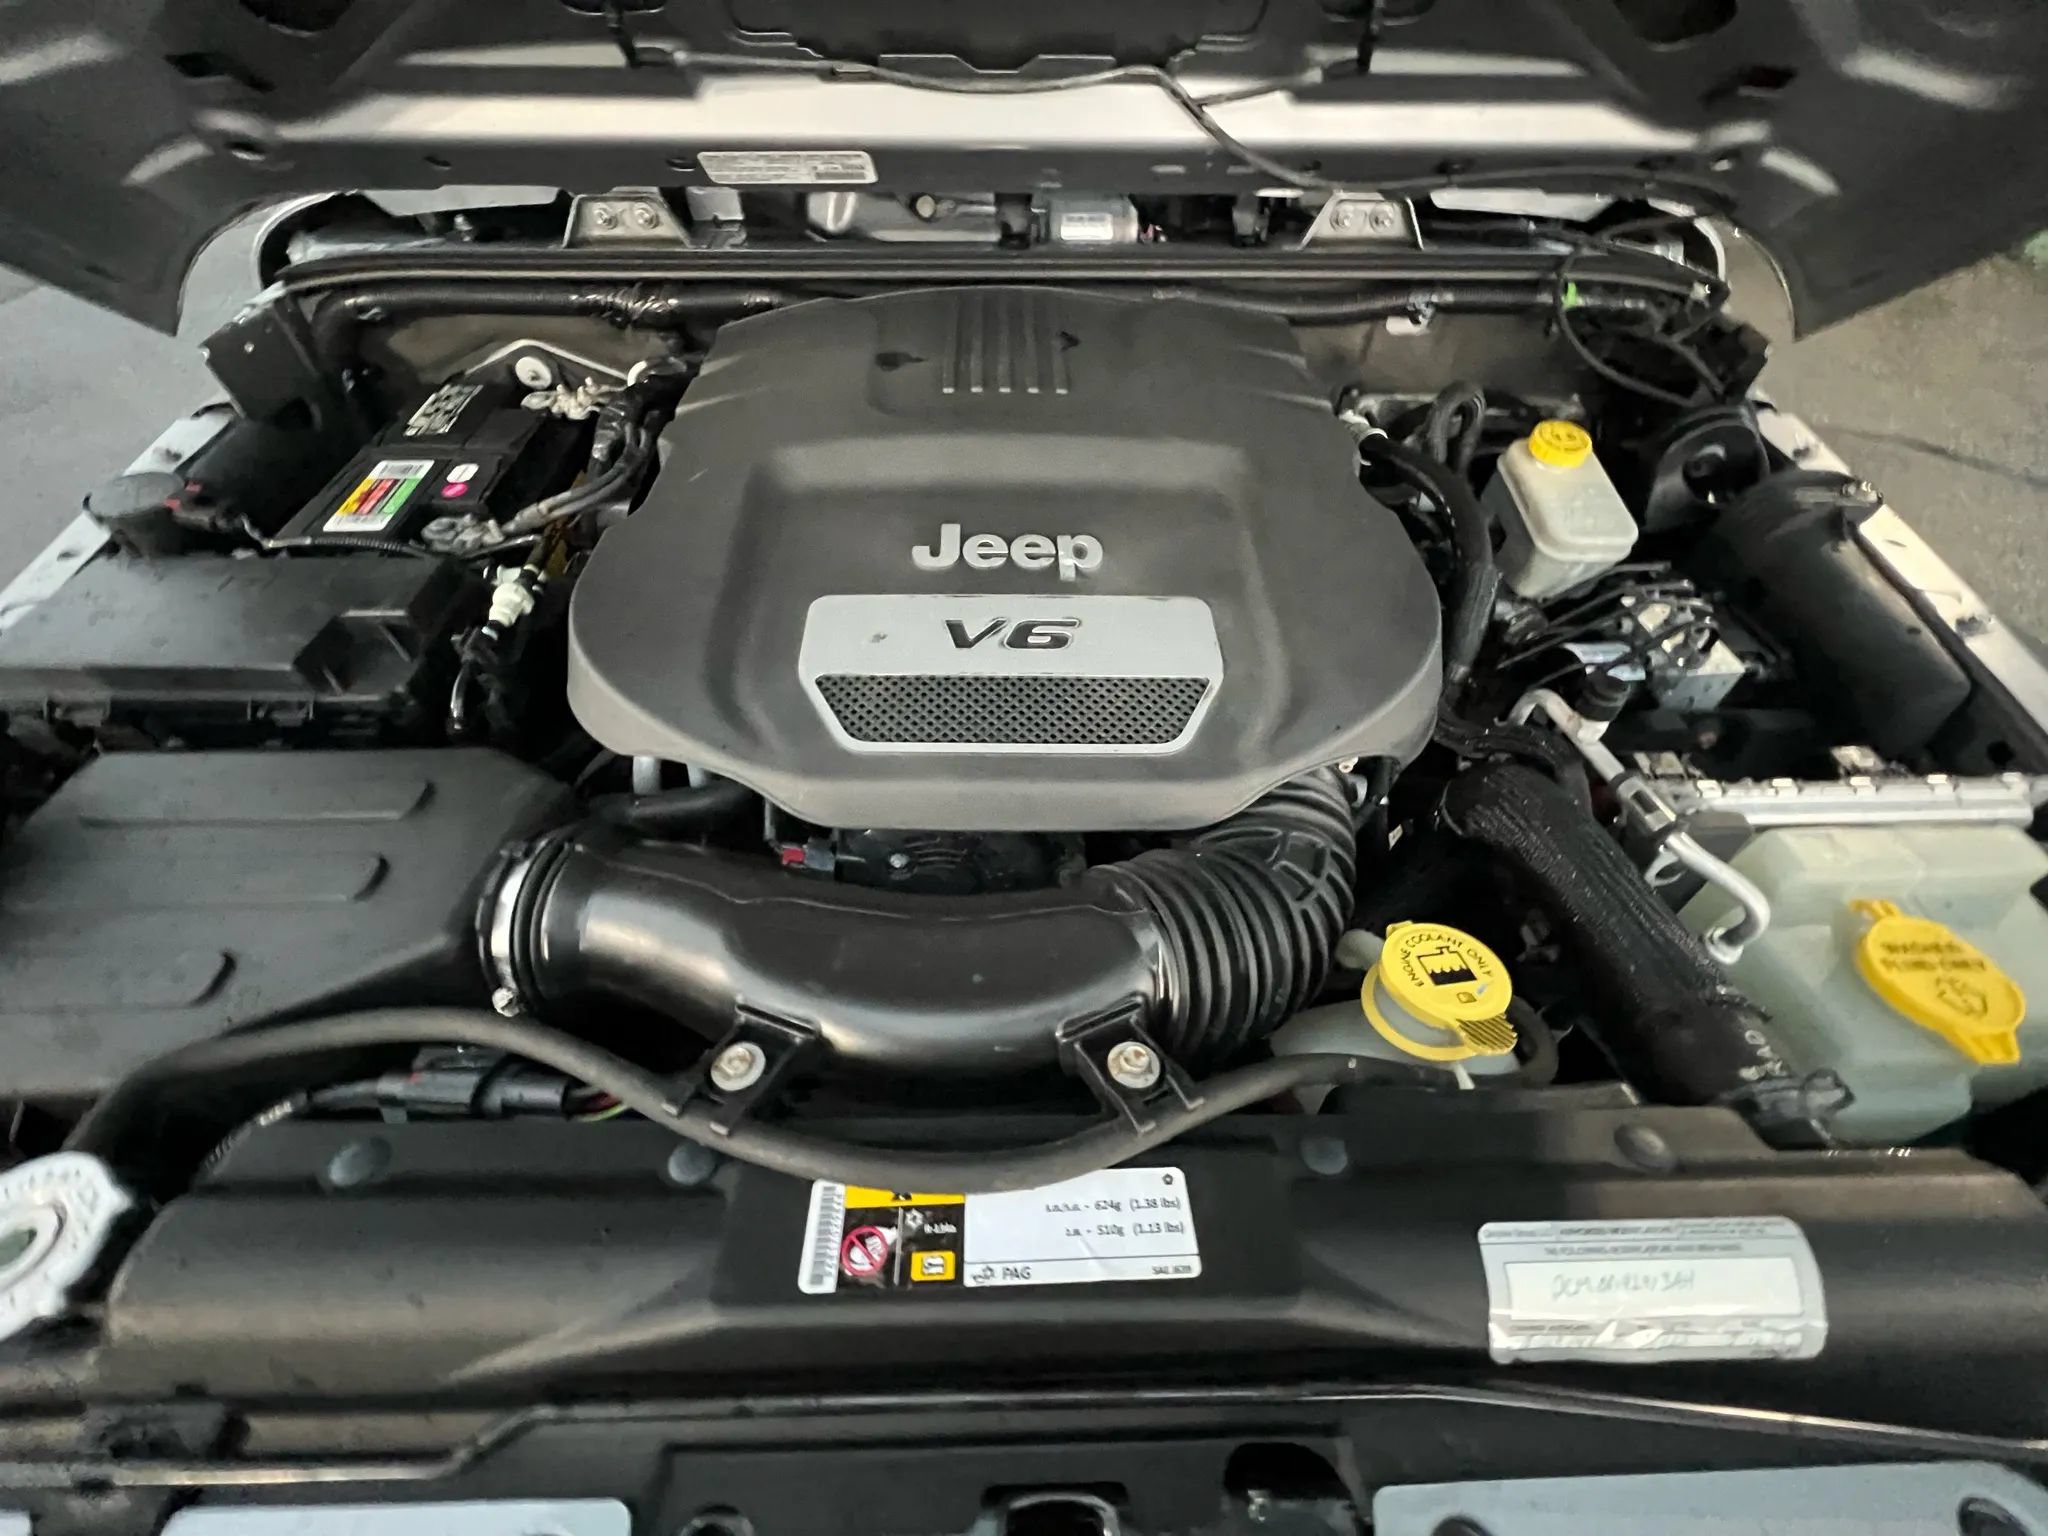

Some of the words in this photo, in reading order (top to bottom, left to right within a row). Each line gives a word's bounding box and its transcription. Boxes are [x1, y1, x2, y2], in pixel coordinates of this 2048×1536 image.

[912, 523, 1103, 581] Jeep
[945, 617, 1082, 650] V6
[1405, 932, 1463, 948] COOLANT
[1002, 1266, 1033, 1281] PAG
